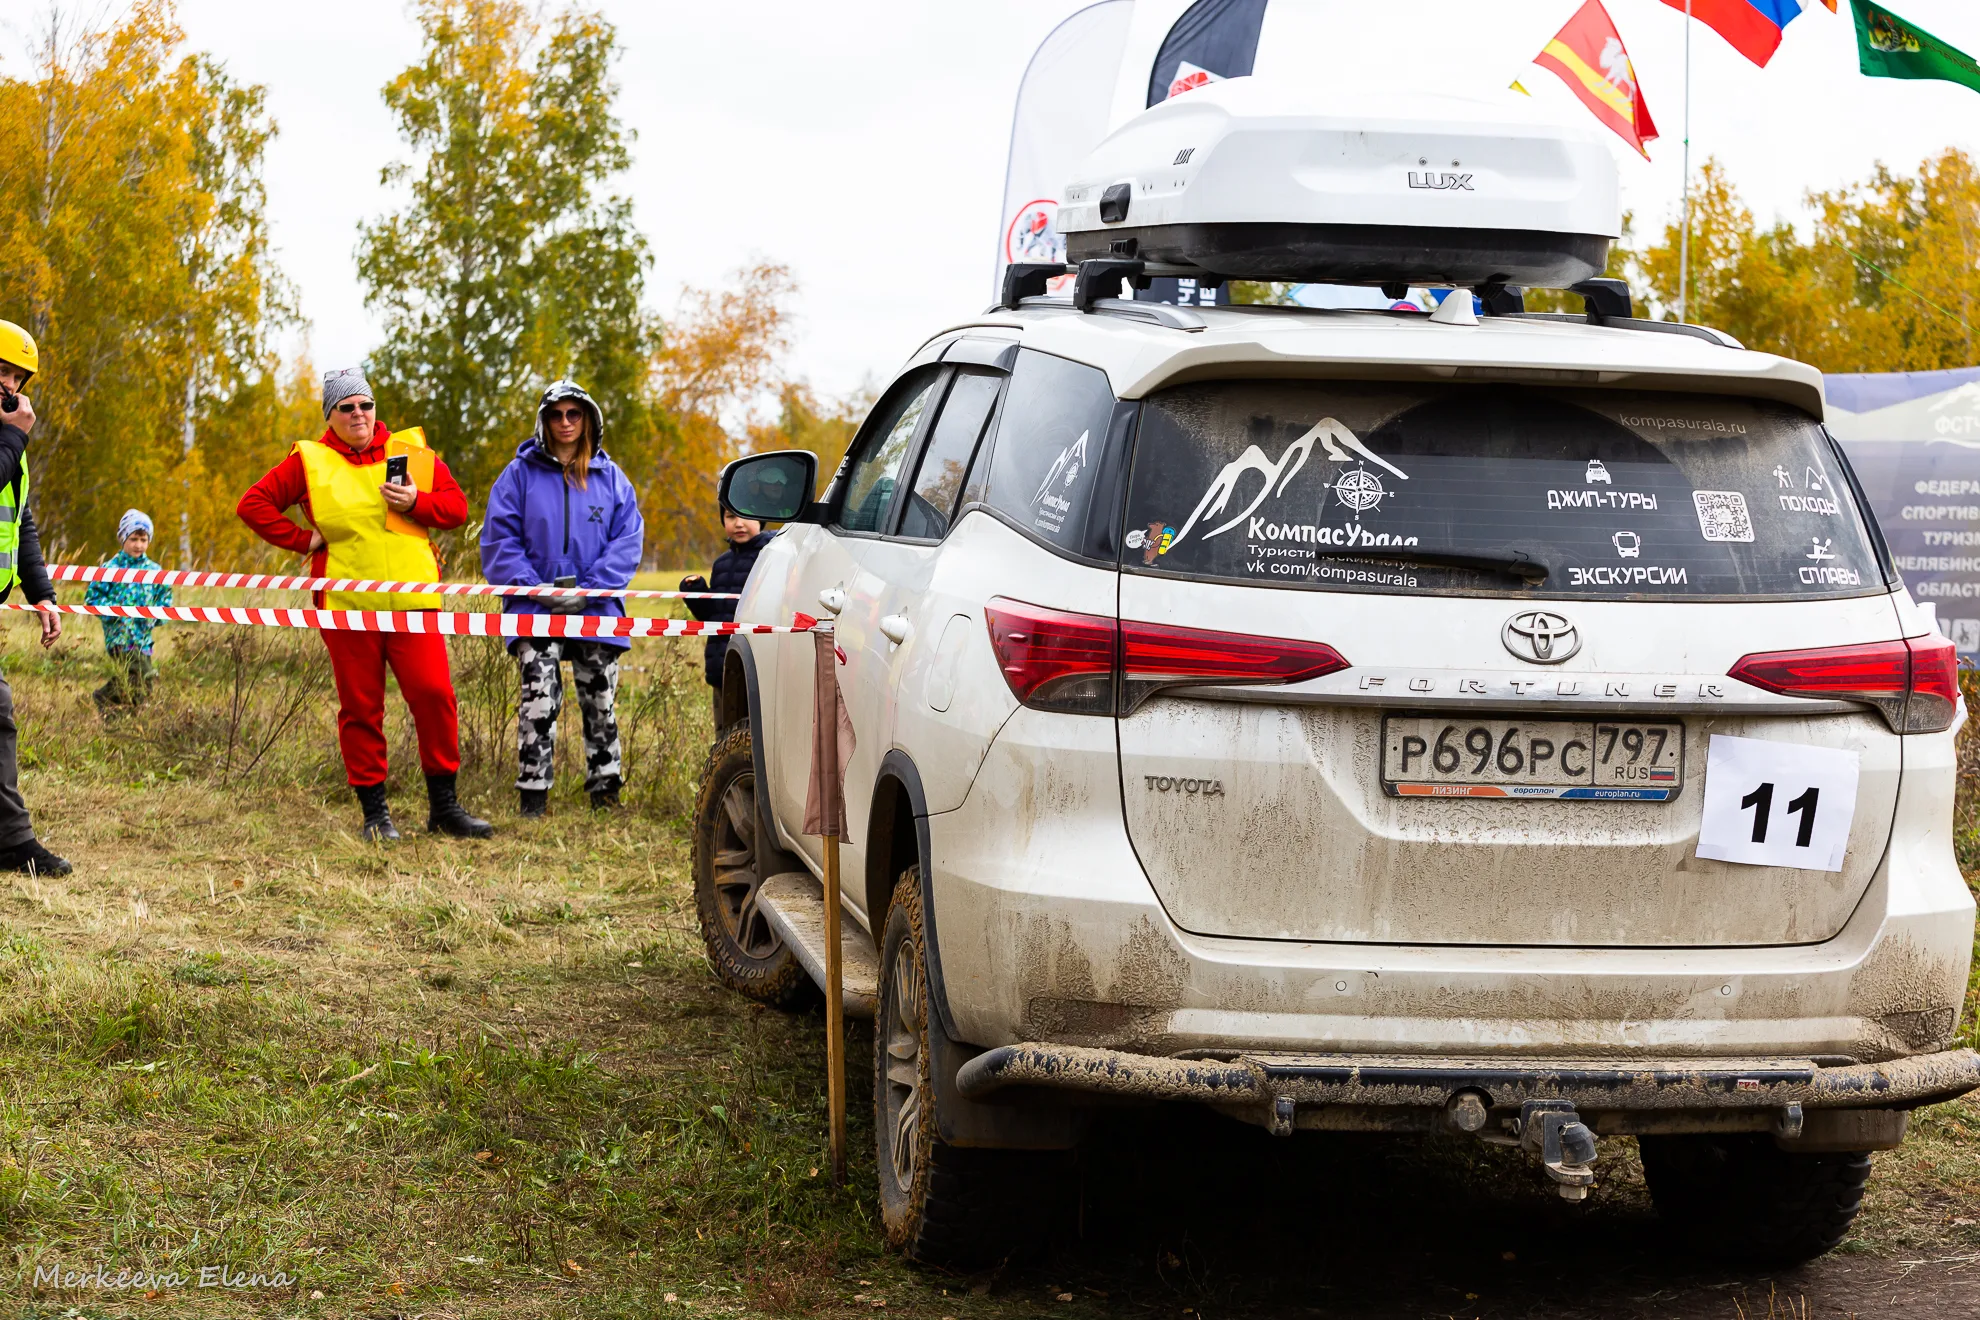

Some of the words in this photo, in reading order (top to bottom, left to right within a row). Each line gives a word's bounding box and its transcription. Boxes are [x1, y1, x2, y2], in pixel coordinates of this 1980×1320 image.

[1408, 171, 1475, 191] LUX
[1619, 412, 1747, 434] kompasurala.ru
[1547, 489, 1658, 511] ДЖИП-ТУРЫ
[1779, 495, 1840, 516] ПОХОДЫ
[1568, 566, 1688, 585] ЭКСКУРСИИ
[1798, 566, 1861, 586] СПЛАВЫ
[1359, 675, 1724, 697] FORTUNER
[1614, 766, 1649, 780] RUS
[1144, 775, 1226, 796] TOYOTA
[1431, 786, 1473, 796] ЛИЗИНГ
[1513, 786, 1556, 796] европлан
[1594, 790, 1641, 800] europlan.ru
[1740, 782, 1820, 848] 11
